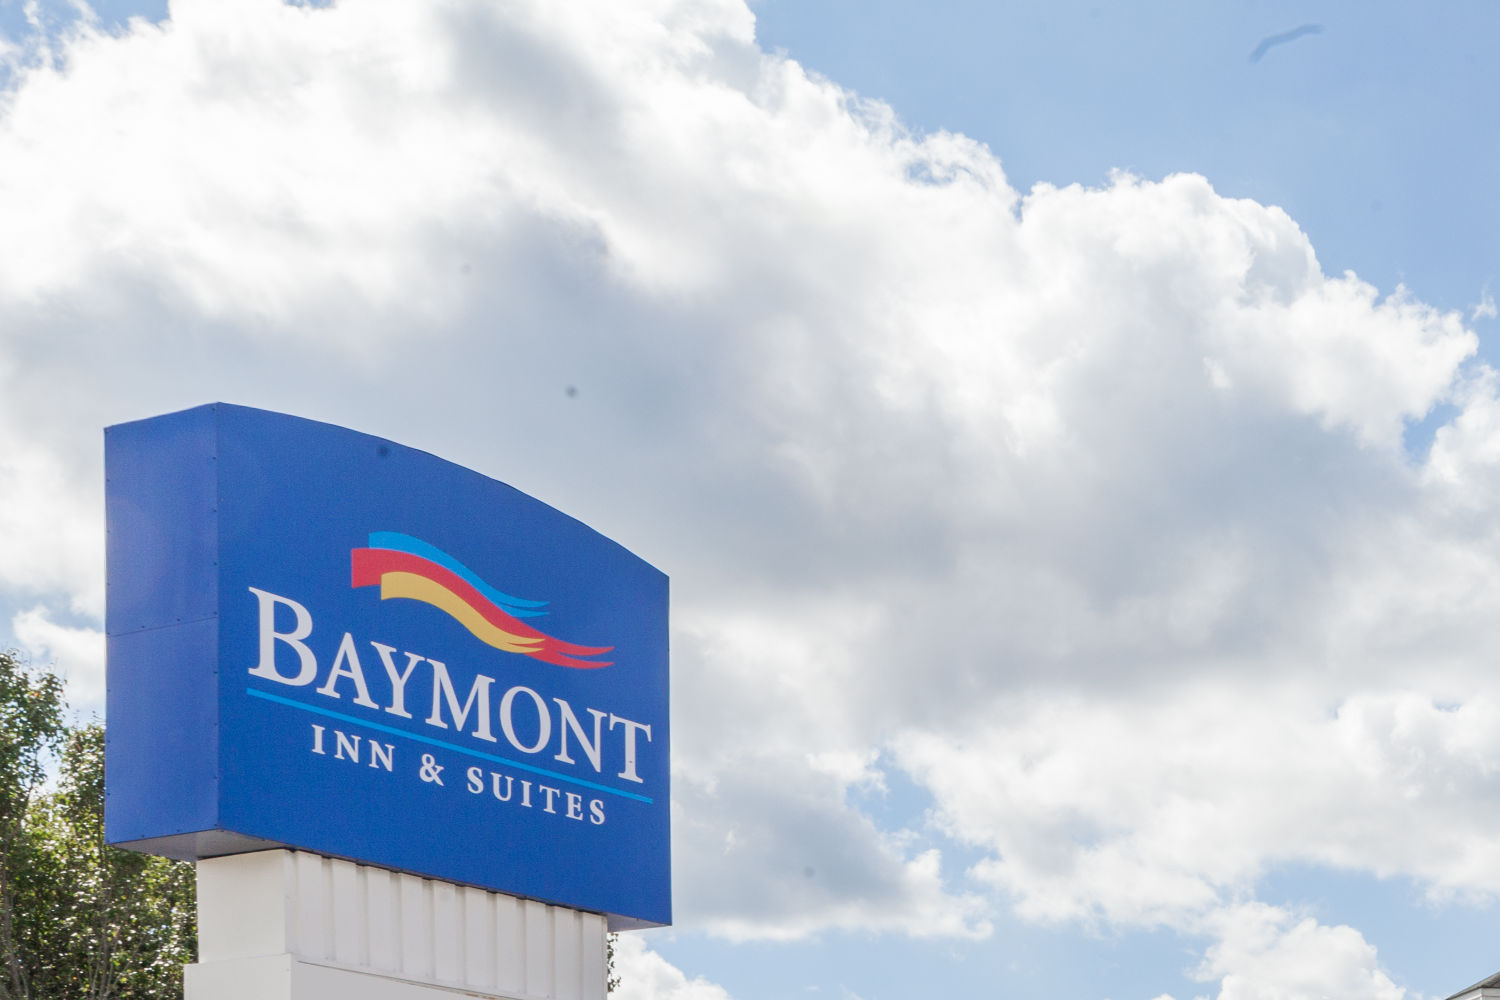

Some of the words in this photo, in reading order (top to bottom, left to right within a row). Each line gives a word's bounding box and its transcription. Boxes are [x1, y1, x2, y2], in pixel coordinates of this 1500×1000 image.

[247, 586, 652, 784] BAYMONT
[311, 724, 395, 772] INN
[419, 753, 445, 787] &
[466, 766, 606, 825] SUITES
